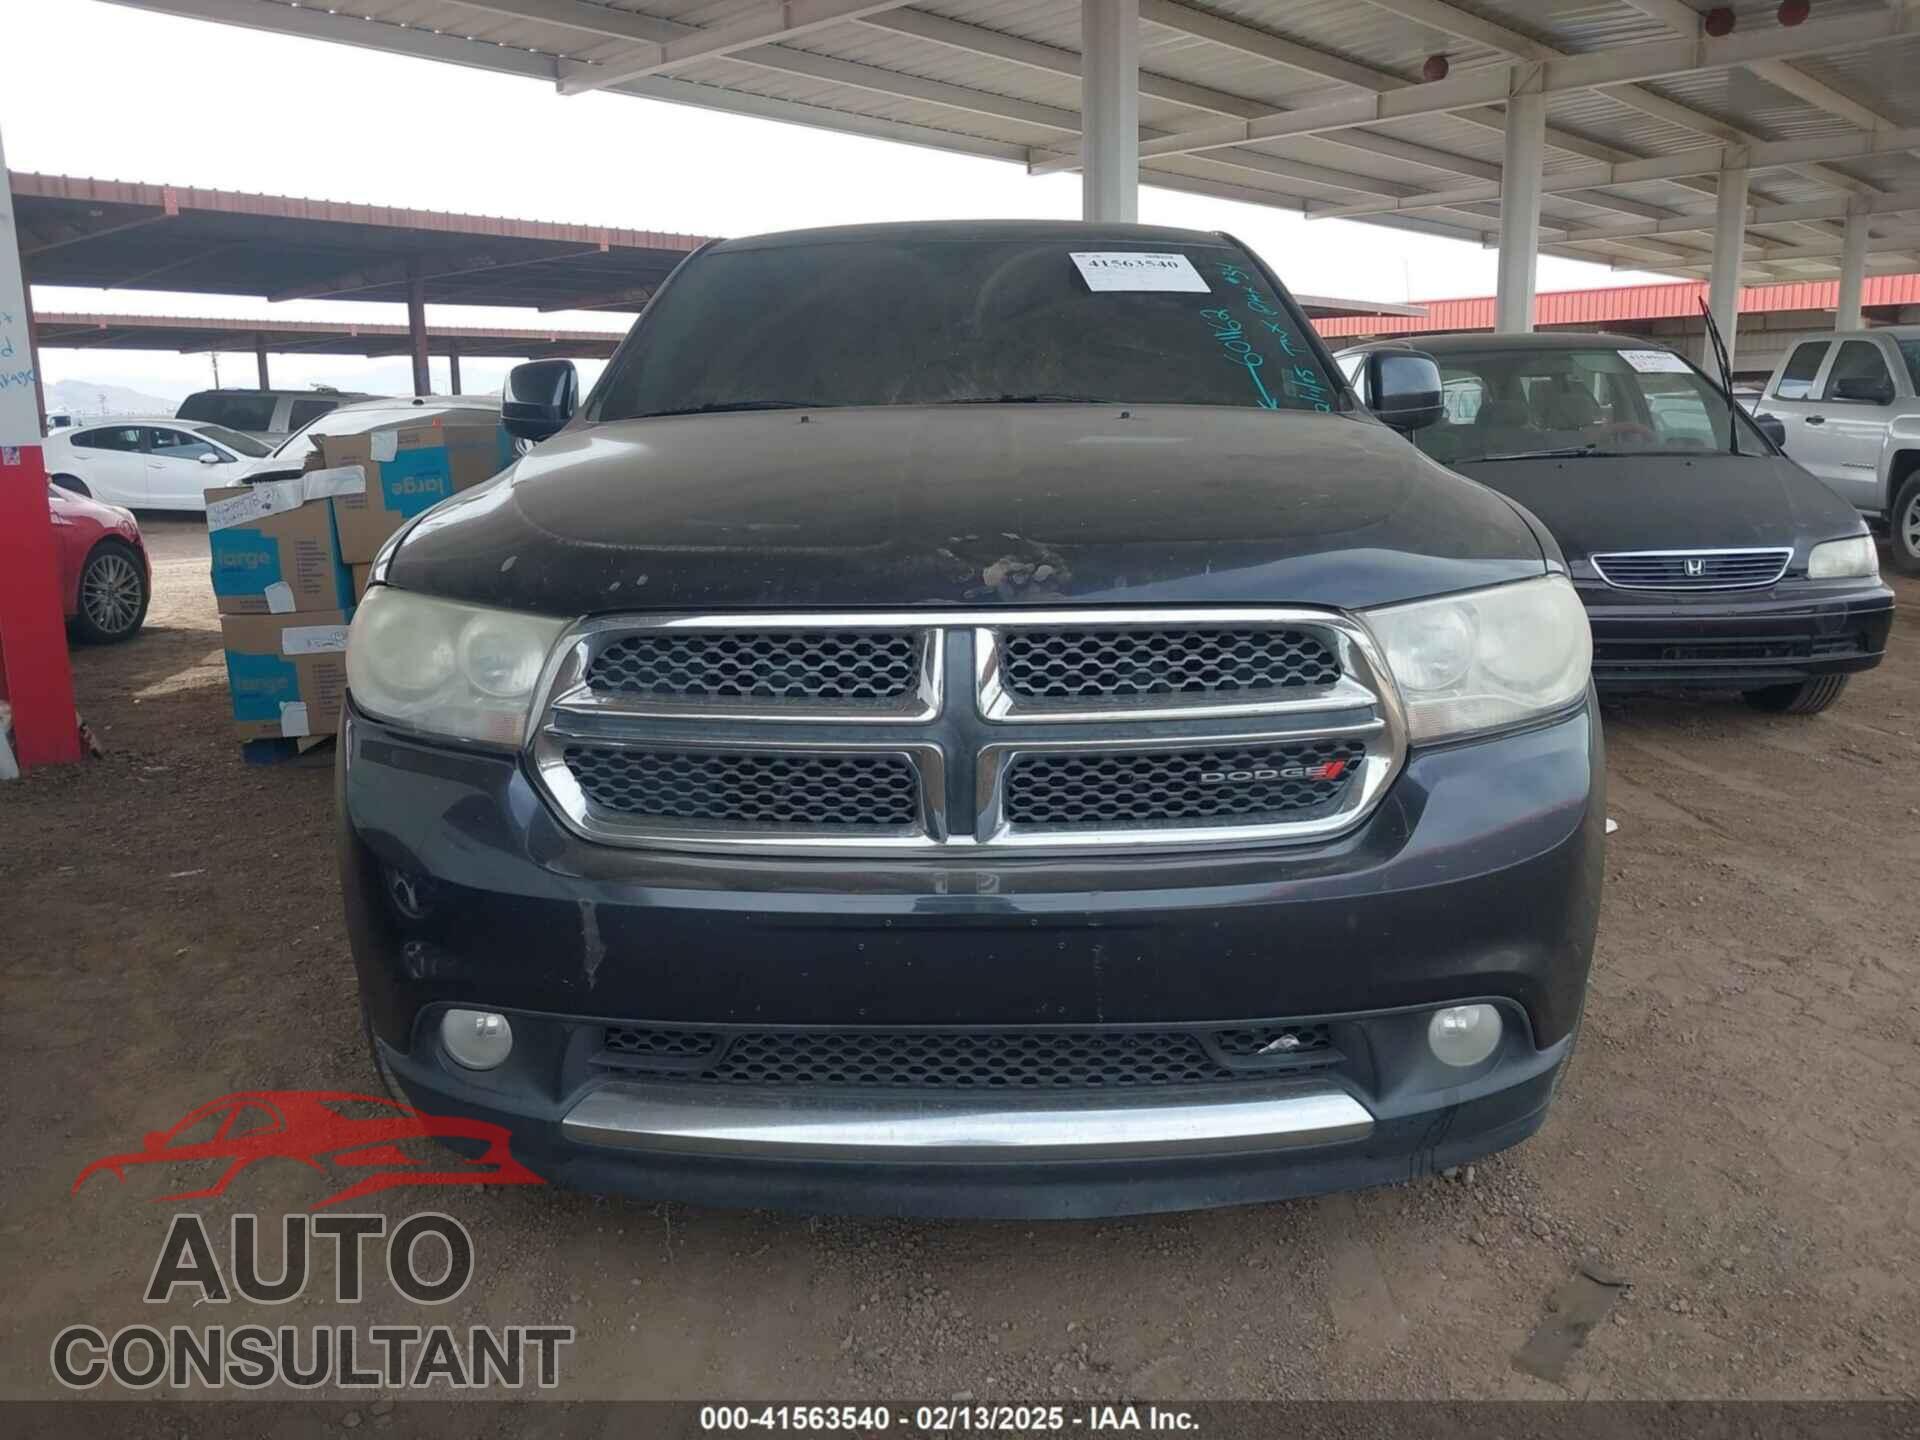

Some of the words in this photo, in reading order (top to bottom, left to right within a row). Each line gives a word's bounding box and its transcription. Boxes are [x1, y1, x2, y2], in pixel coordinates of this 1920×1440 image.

[1089, 259, 1179, 269] 41563540
[391, 475, 444, 495] large
[221, 547, 271, 569] large
[1201, 766, 1327, 783] DODGE
